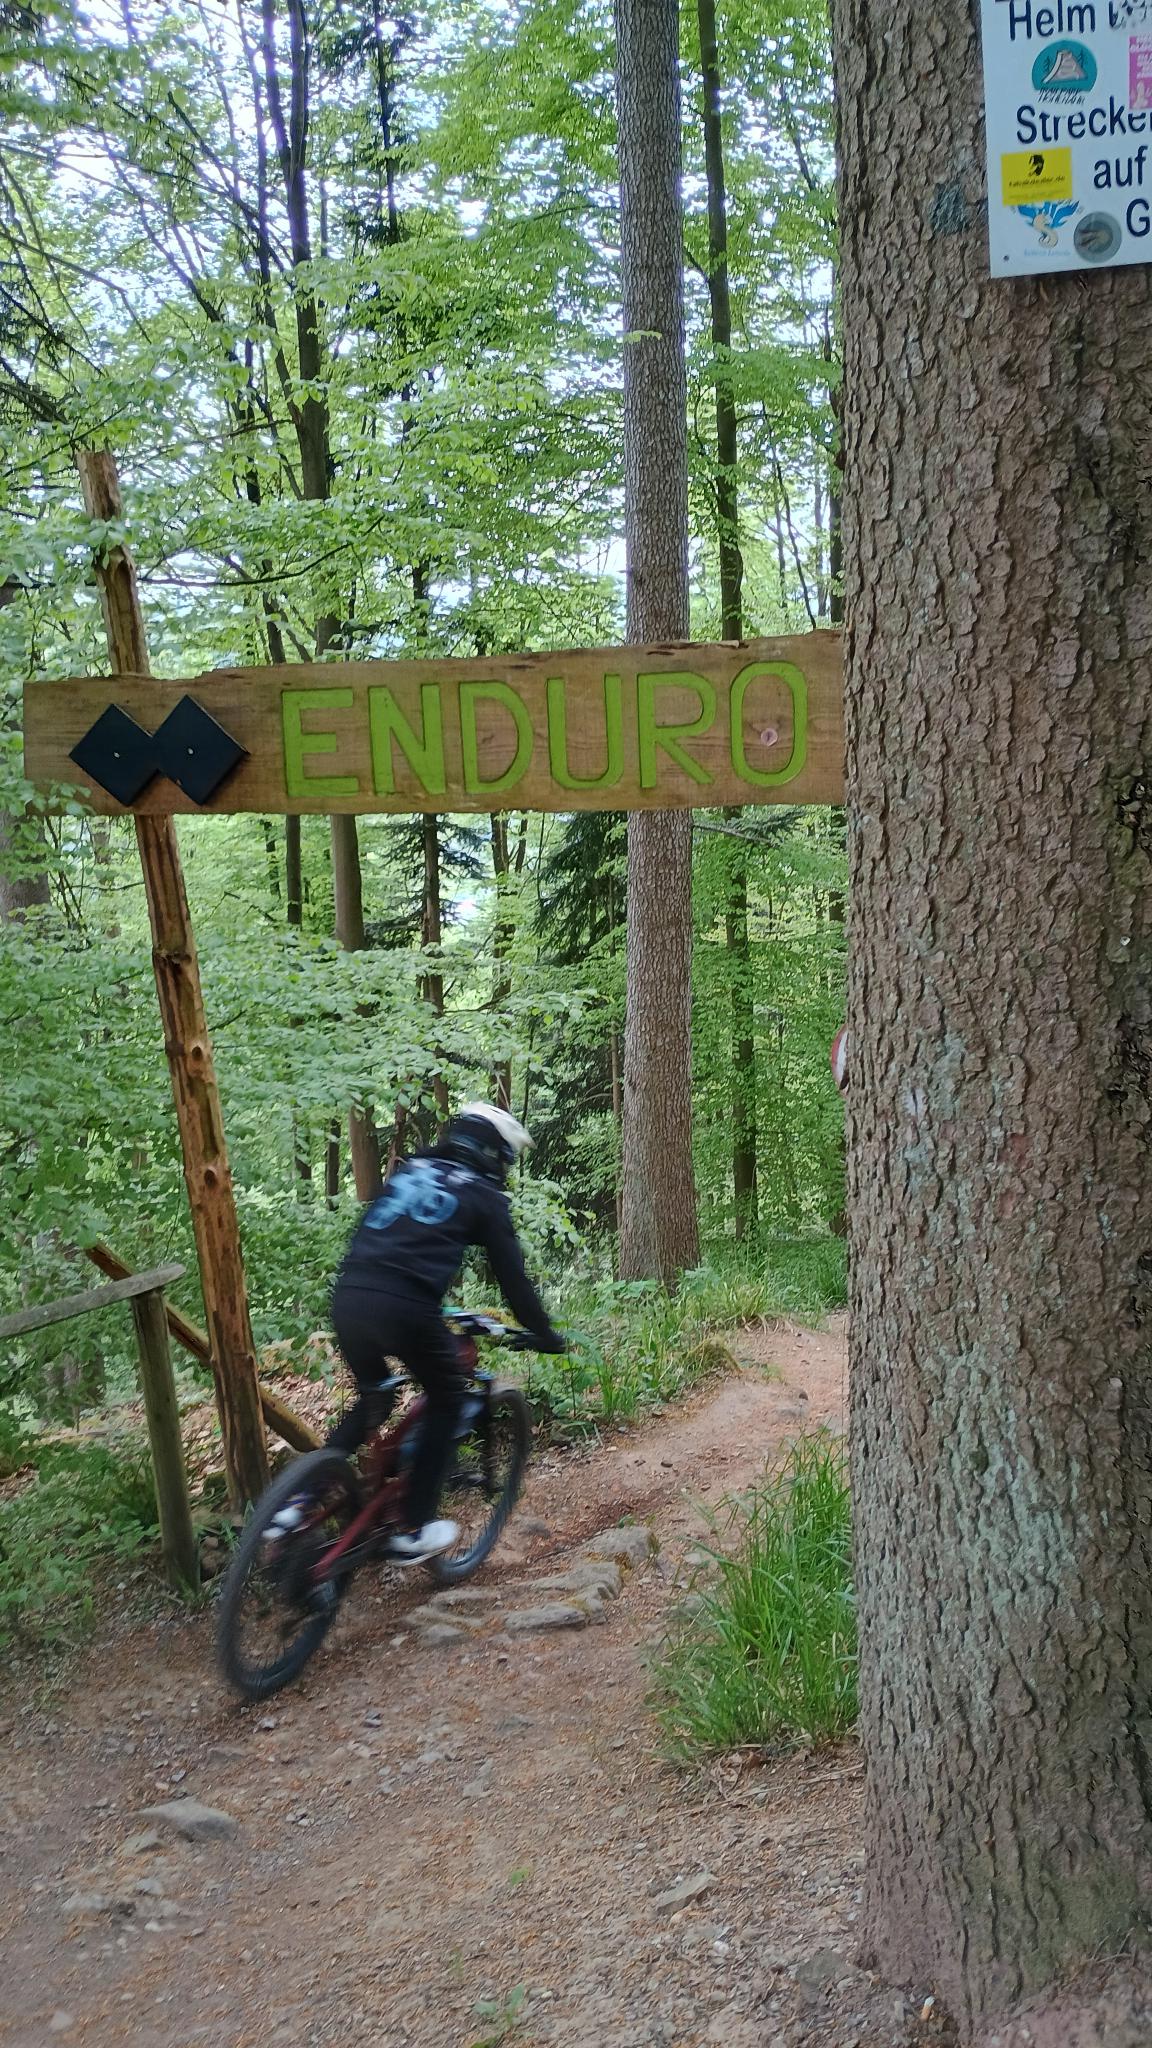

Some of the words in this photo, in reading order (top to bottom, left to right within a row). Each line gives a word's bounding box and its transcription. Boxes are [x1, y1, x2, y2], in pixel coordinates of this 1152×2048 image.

[1009, 0, 1096, 41] Helm
[1017, 96, 1152, 144] Strecke
[1093, 146, 1148, 189] auf
[281, 660, 808, 797] ENDURO
